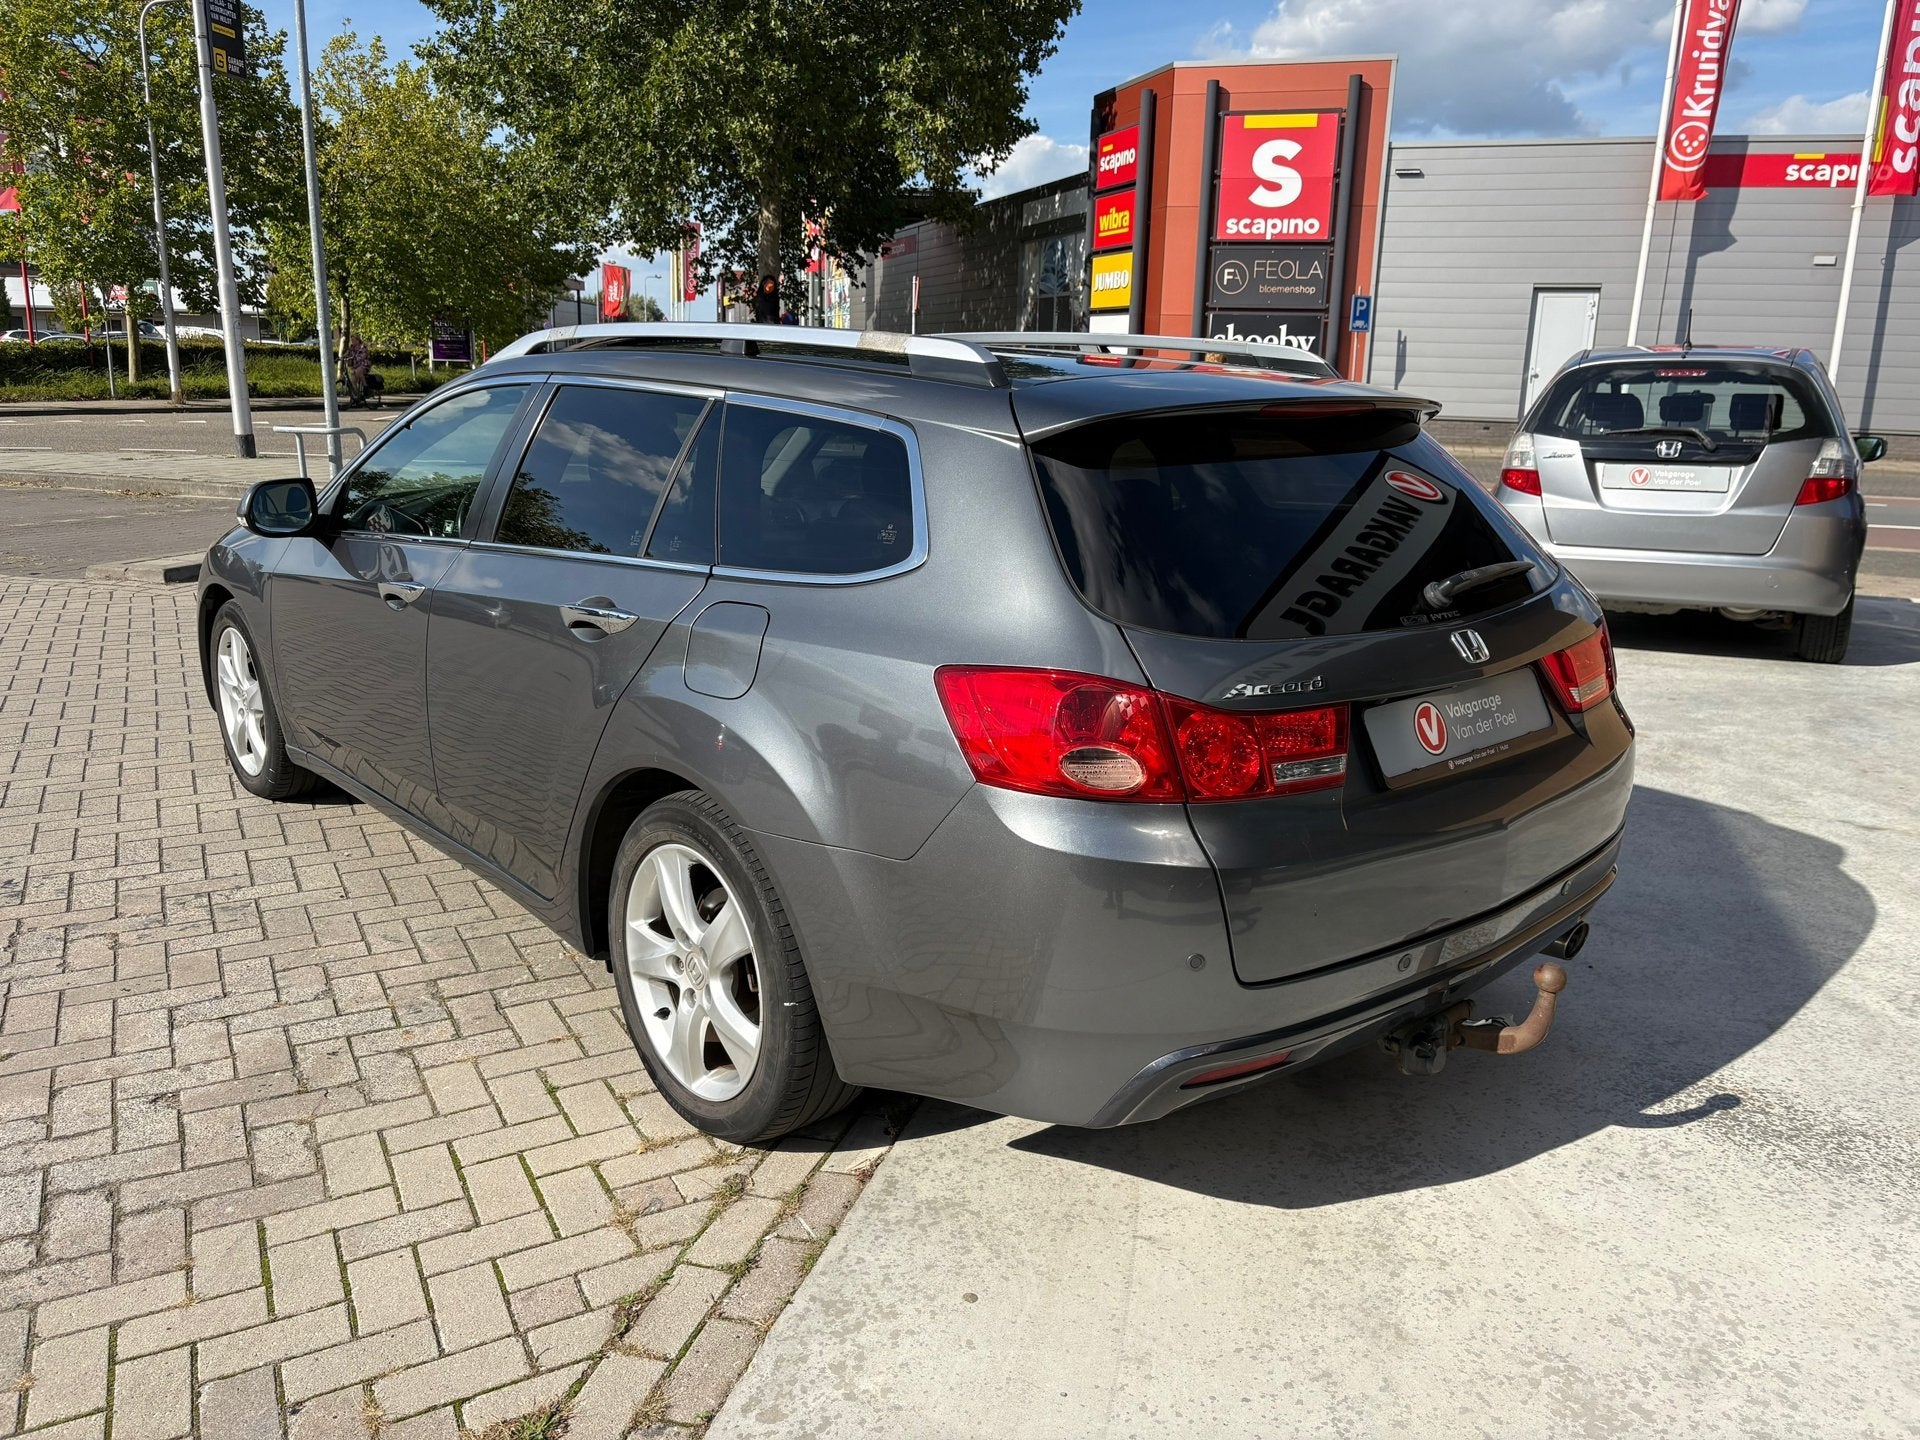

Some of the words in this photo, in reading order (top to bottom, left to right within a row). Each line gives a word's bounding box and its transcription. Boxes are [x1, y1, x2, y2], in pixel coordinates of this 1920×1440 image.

[1099, 147, 1136, 174] scapino
[1248, 138, 1303, 208] S
[1099, 206, 1130, 231] wibra
[1225, 216, 1320, 241] scapino
[1093, 269, 1130, 292] JUMBO
[1253, 260, 1324, 280] FEOLA
[1258, 284, 1316, 295] bloemenshop
[1654, 469, 1695, 479] Vakgarage
[1670, 478, 1683, 486] der
[1684, 479, 1702, 488] Poel
[1221, 675, 1324, 700] Accord
[1445, 694, 1502, 719] Vakgarage
[1451, 724, 1476, 740] Van
[1476, 718, 1494, 734] der
[1495, 708, 1518, 728] Poel
